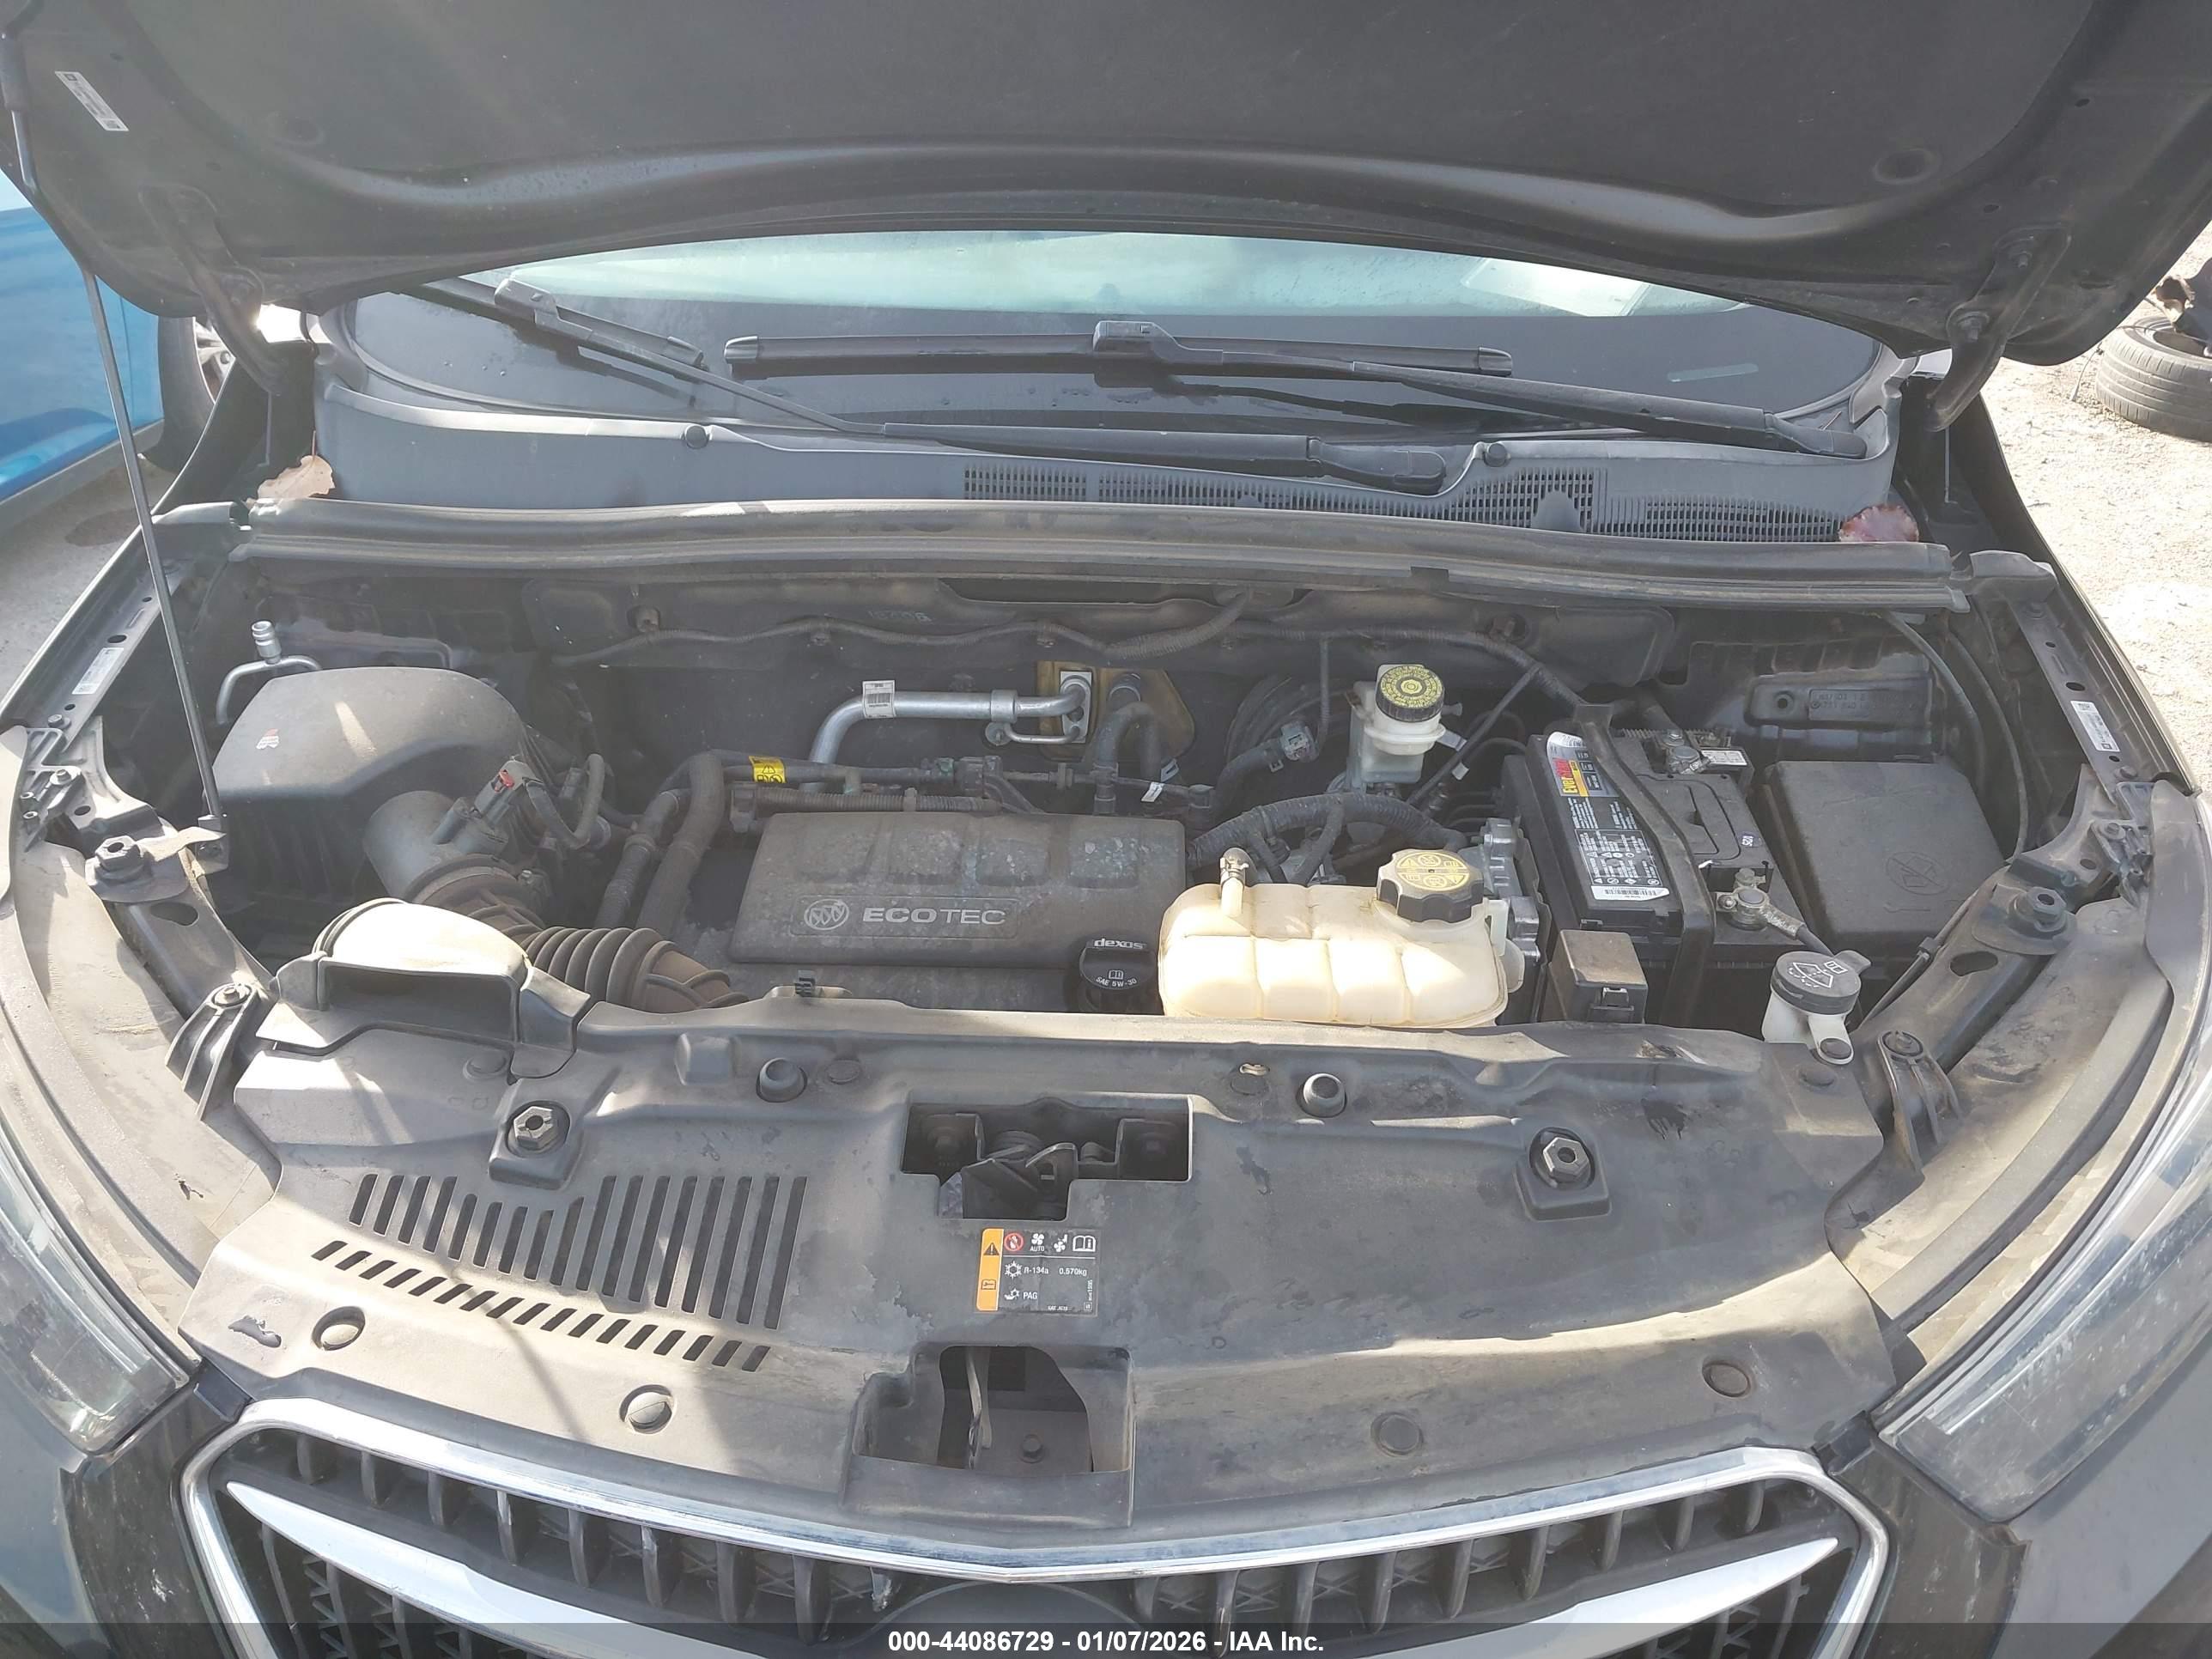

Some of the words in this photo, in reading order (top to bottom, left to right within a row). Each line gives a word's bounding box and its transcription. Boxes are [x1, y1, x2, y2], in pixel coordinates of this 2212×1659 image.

[862, 907, 1006, 925] ECOTEC
[1094, 938, 1144, 950] dexos
[1096, 976, 1110, 987] SAE
[1111, 977, 1138, 988] 5W-30
[1024, 1266, 1049, 1274] R-134a
[1059, 1267, 1087, 1277] 0.570kg
[1023, 1291, 1038, 1300] PAG
